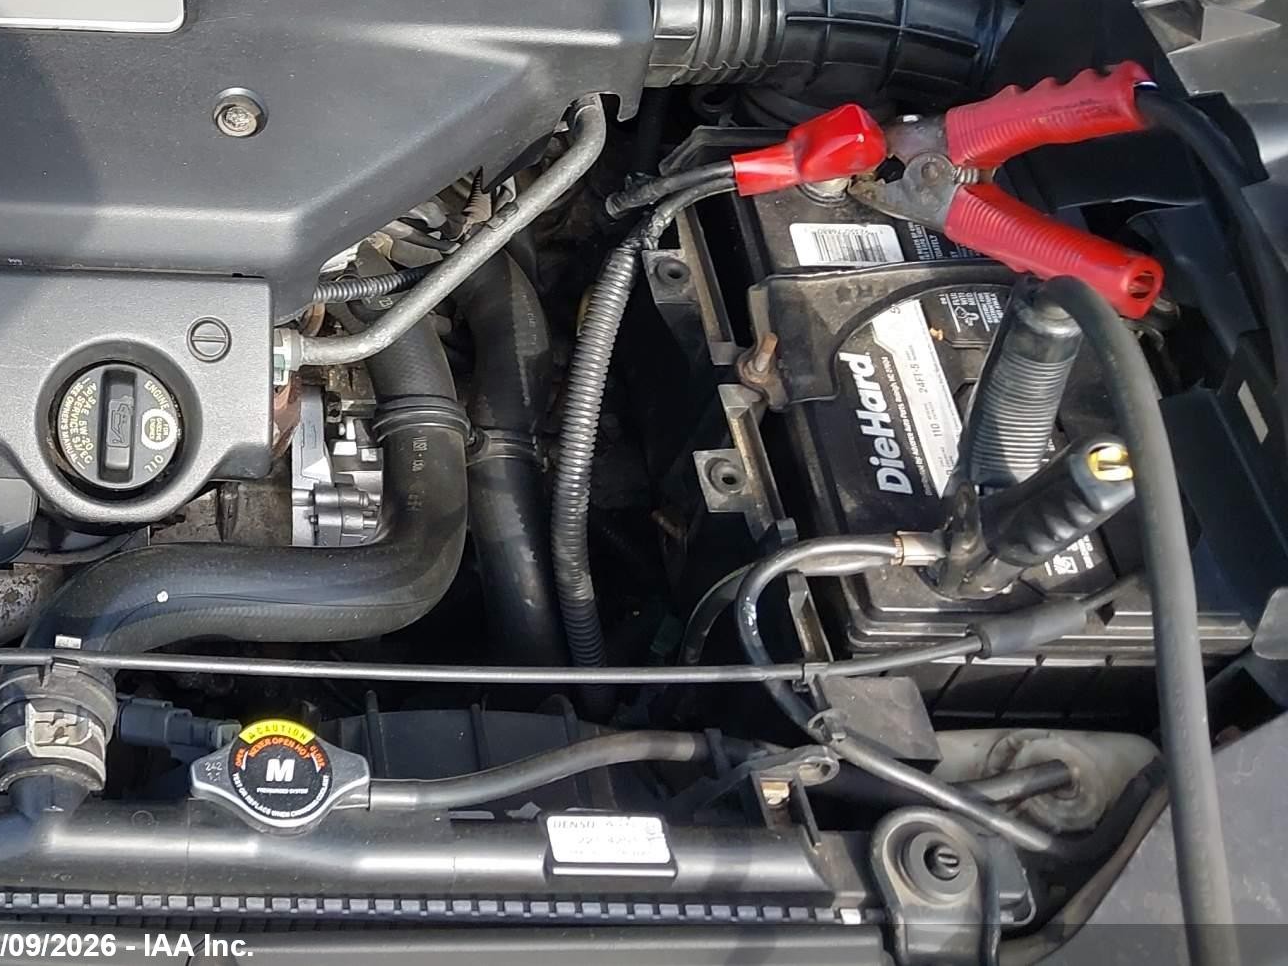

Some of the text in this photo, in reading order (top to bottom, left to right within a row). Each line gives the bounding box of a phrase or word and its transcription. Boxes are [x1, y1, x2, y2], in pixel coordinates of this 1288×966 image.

[82, 382, 97, 397] API
[144, 379, 170, 411] ENGINE
[61, 382, 83, 463] SEE OWNER'S MANUAL
[69, 395, 85, 435] SERVICE
[79, 396, 97, 452] SAE 5W-20
[839, 352, 914, 495] DieHard
[144, 454, 164, 473] OIL
[255, 724, 308, 741] CAUTION
[248, 737, 312, 760] NEVER OPEN HOT
[265, 758, 296, 782] M
[245, 794, 272, 817] REPLACE
